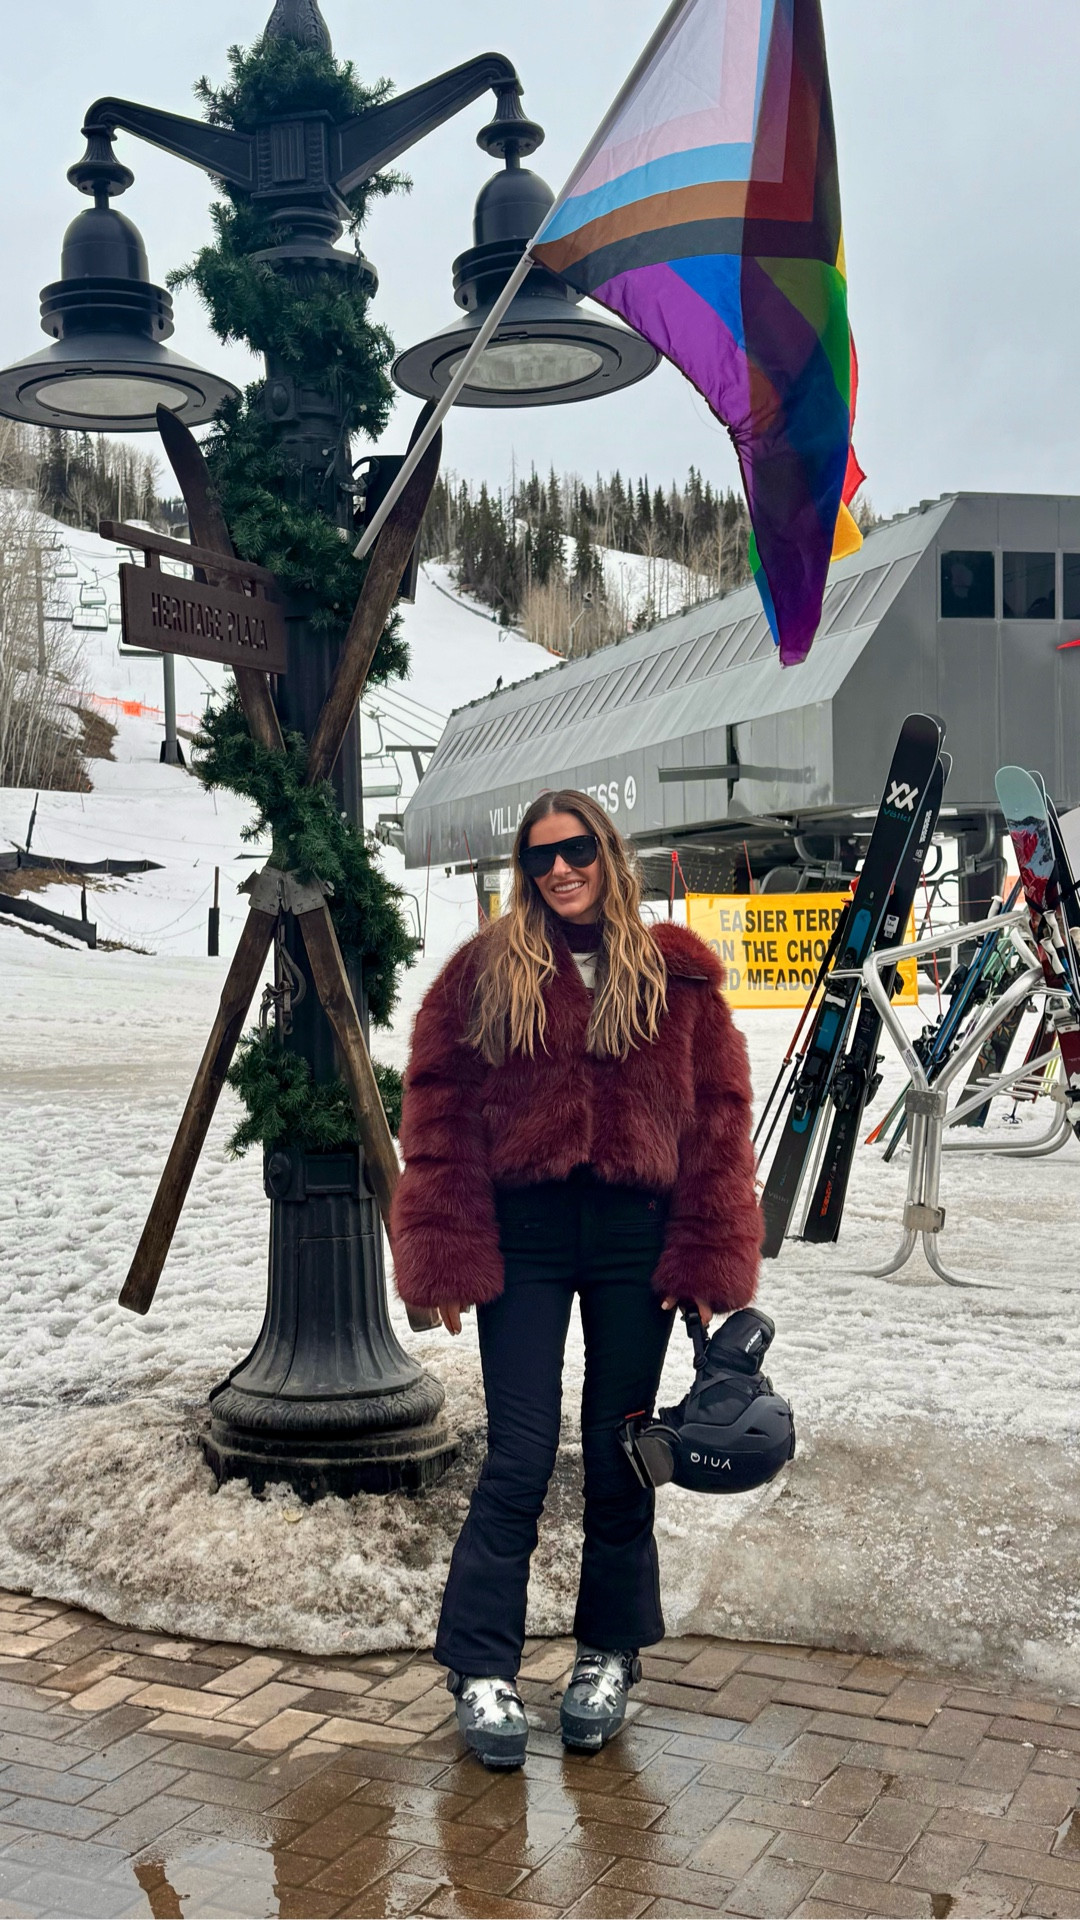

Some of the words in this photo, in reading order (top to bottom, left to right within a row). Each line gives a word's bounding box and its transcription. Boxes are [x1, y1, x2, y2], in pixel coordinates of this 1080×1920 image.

[151, 592, 224, 641] HERITAGE
[227, 610, 268, 651] PLAZA
[719, 909, 788, 933] EASIER
[741, 940, 778, 963] THE
[787, 939, 832, 963] CHO
[747, 968, 818, 991] MEADO
